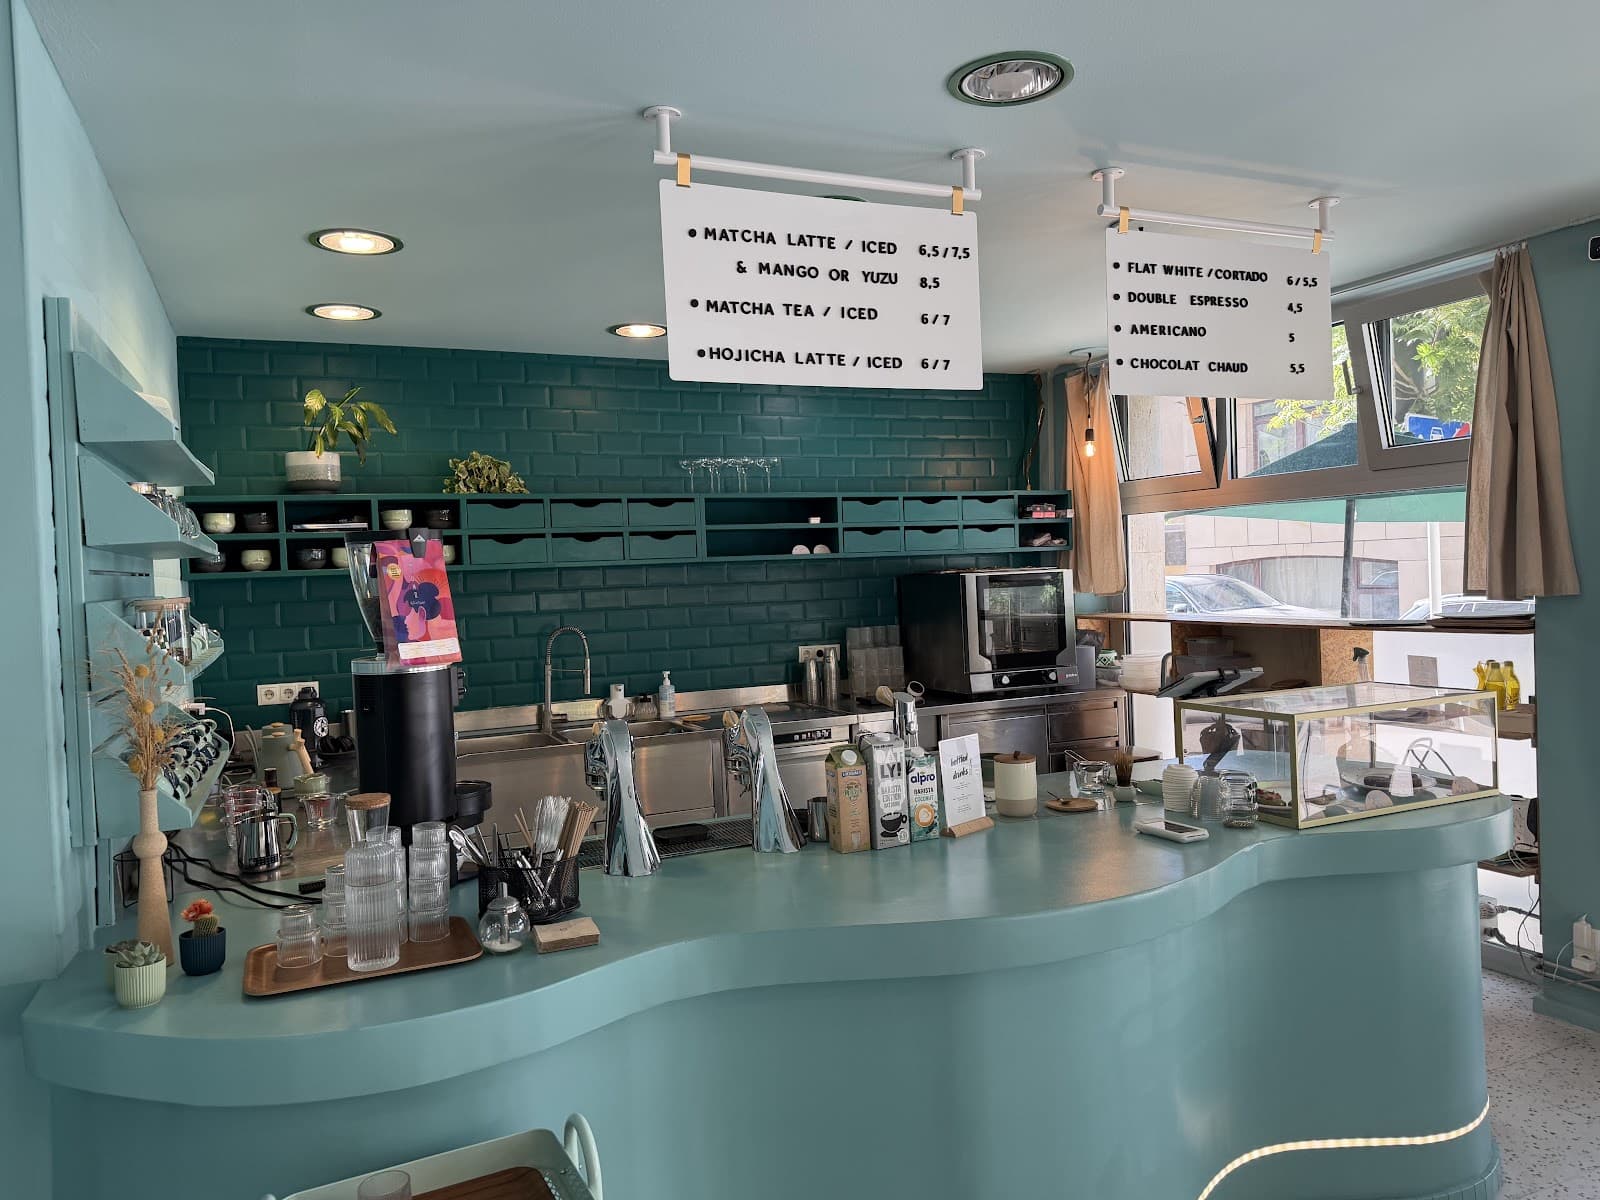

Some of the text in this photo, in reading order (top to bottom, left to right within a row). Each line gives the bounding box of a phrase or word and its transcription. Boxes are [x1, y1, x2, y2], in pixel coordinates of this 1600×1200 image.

[704, 226, 777, 245] MATCHA
[787, 233, 837, 250] LATTE
[844, 239, 853, 250] /
[861, 240, 898, 255] ICED
[736, 260, 940, 290] & MANGO OR YUZU 8,5
[1127, 261, 1158, 275] FLAT
[1162, 264, 1204, 278] WHITE
[706, 299, 775, 316] MATCHA
[782, 303, 815, 318] TEA
[823, 306, 831, 317] /
[840, 306, 878, 321] ICED
[1127, 291, 1303, 314] DOUBLE ESPRESSO 4,5
[1130, 324, 1295, 343] AMERICANO 5
[709, 346, 786, 364] HOJICHA
[794, 351, 846, 367] LATTE
[852, 356, 860, 367] /
[867, 356, 903, 370] ICED
[1130, 357, 1305, 375] CHOCOLAT CHAUD 5,5
[880, 762, 902, 778] LY!
[910, 773, 936, 785] alpro
[913, 787, 934, 795] BARISTA
